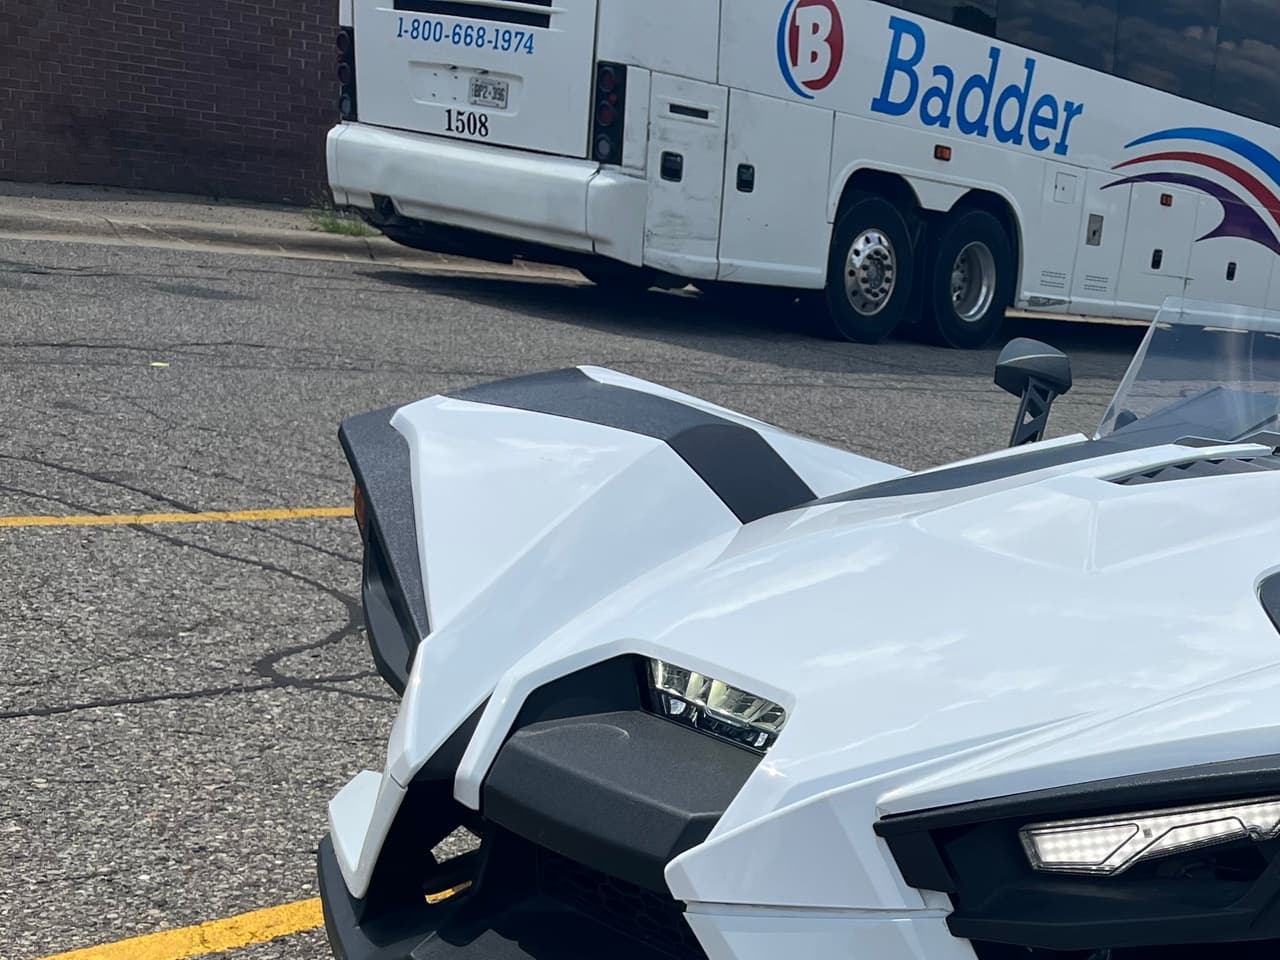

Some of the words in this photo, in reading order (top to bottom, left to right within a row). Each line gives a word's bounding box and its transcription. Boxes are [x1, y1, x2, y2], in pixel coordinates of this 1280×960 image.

[397, 17, 534, 54] 1-800-668-1974
[870, 15, 1084, 156] Badder
[445, 108, 489, 137] 1508
